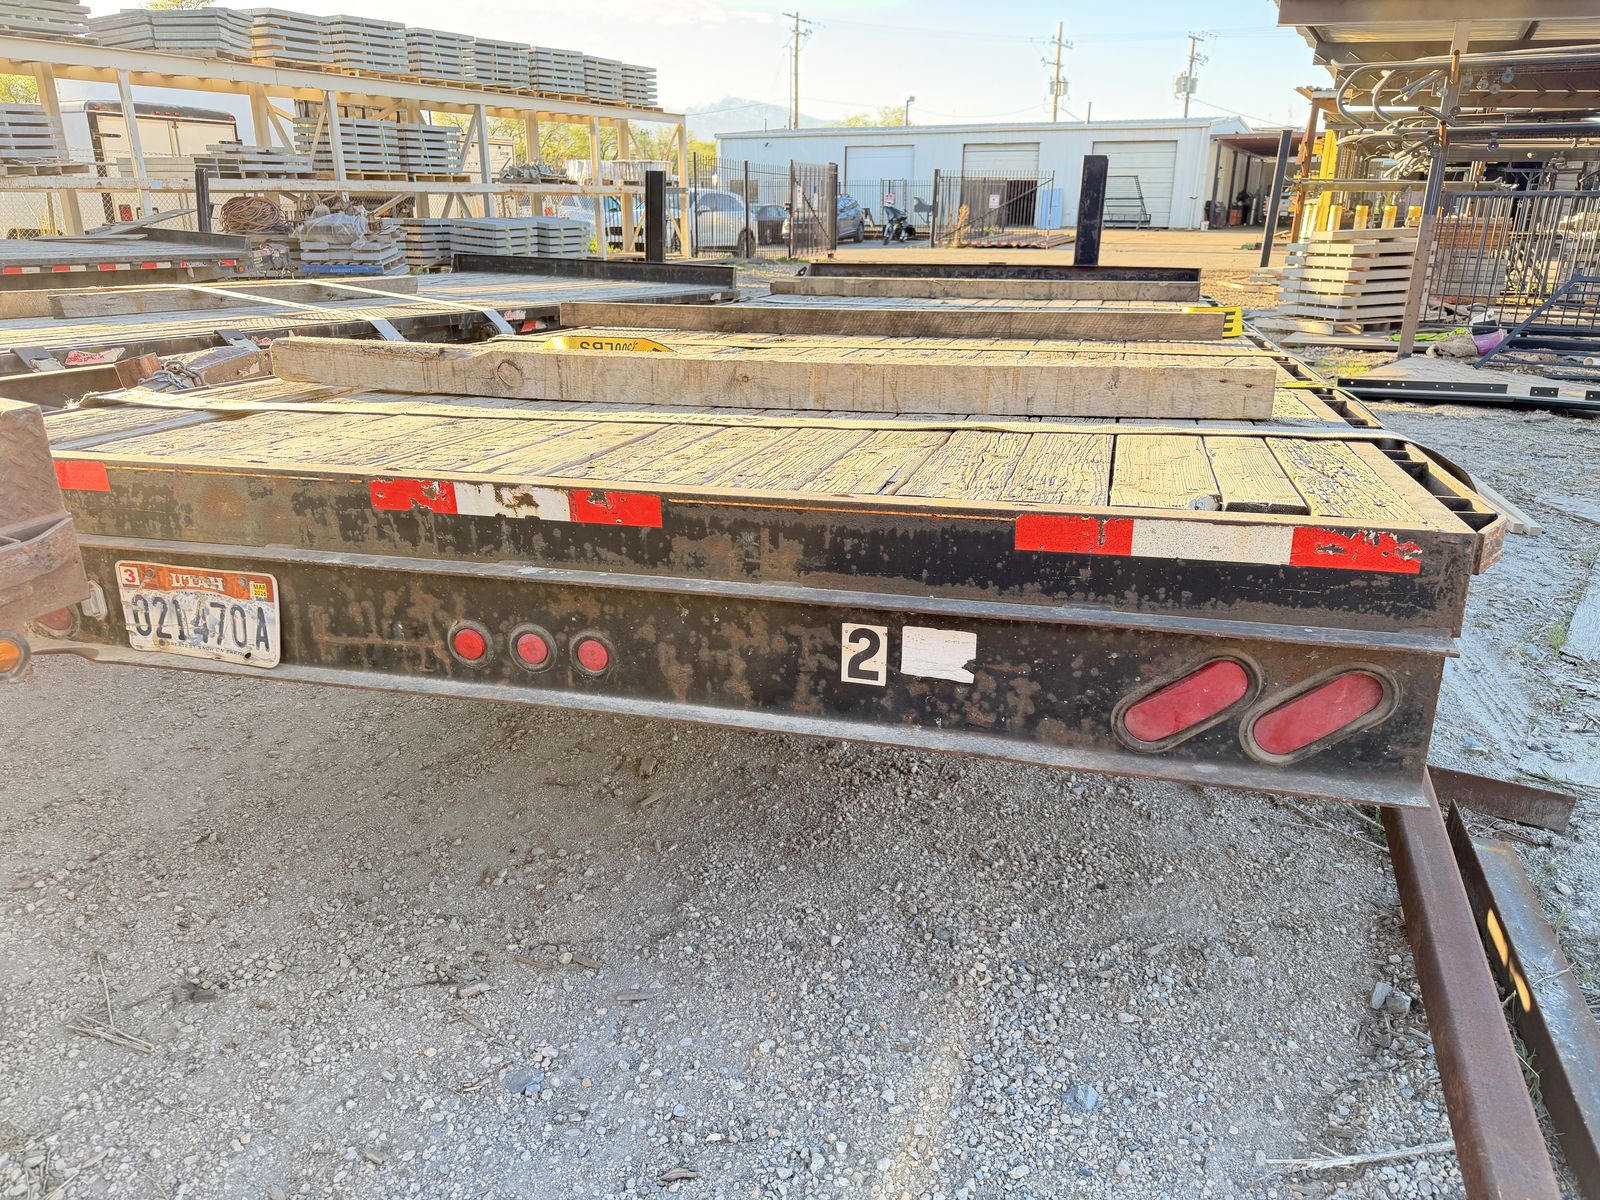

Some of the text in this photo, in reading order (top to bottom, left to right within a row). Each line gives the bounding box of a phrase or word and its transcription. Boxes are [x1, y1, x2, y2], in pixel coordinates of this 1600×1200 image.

[124, 569, 136, 583] 3
[170, 573, 225, 591] UTAH
[132, 595, 270, 652] 021470A
[848, 628, 880, 681] 2
